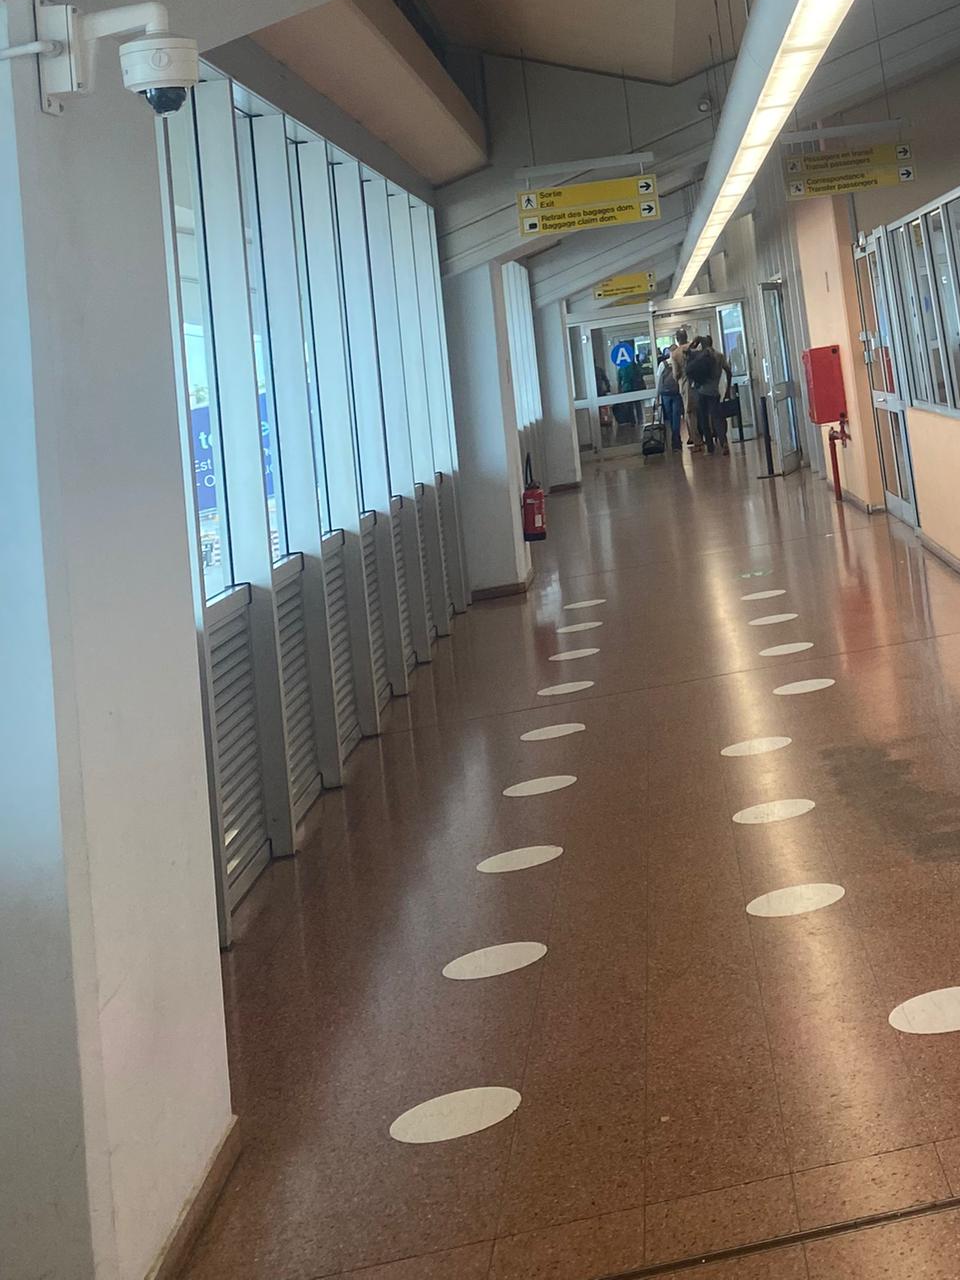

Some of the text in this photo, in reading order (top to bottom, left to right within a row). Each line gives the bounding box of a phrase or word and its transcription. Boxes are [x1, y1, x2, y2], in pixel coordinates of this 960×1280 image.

[838, 179, 878, 190] passengers
[539, 190, 562, 199] Sortie
[540, 200, 555, 209] Exit
[541, 212, 566, 222] Retrait
[567, 211, 582, 219] des
[583, 206, 615, 217] bagages
[542, 221, 576, 231] Baggage
[577, 217, 598, 226] claim
[616, 348, 631, 364] A
